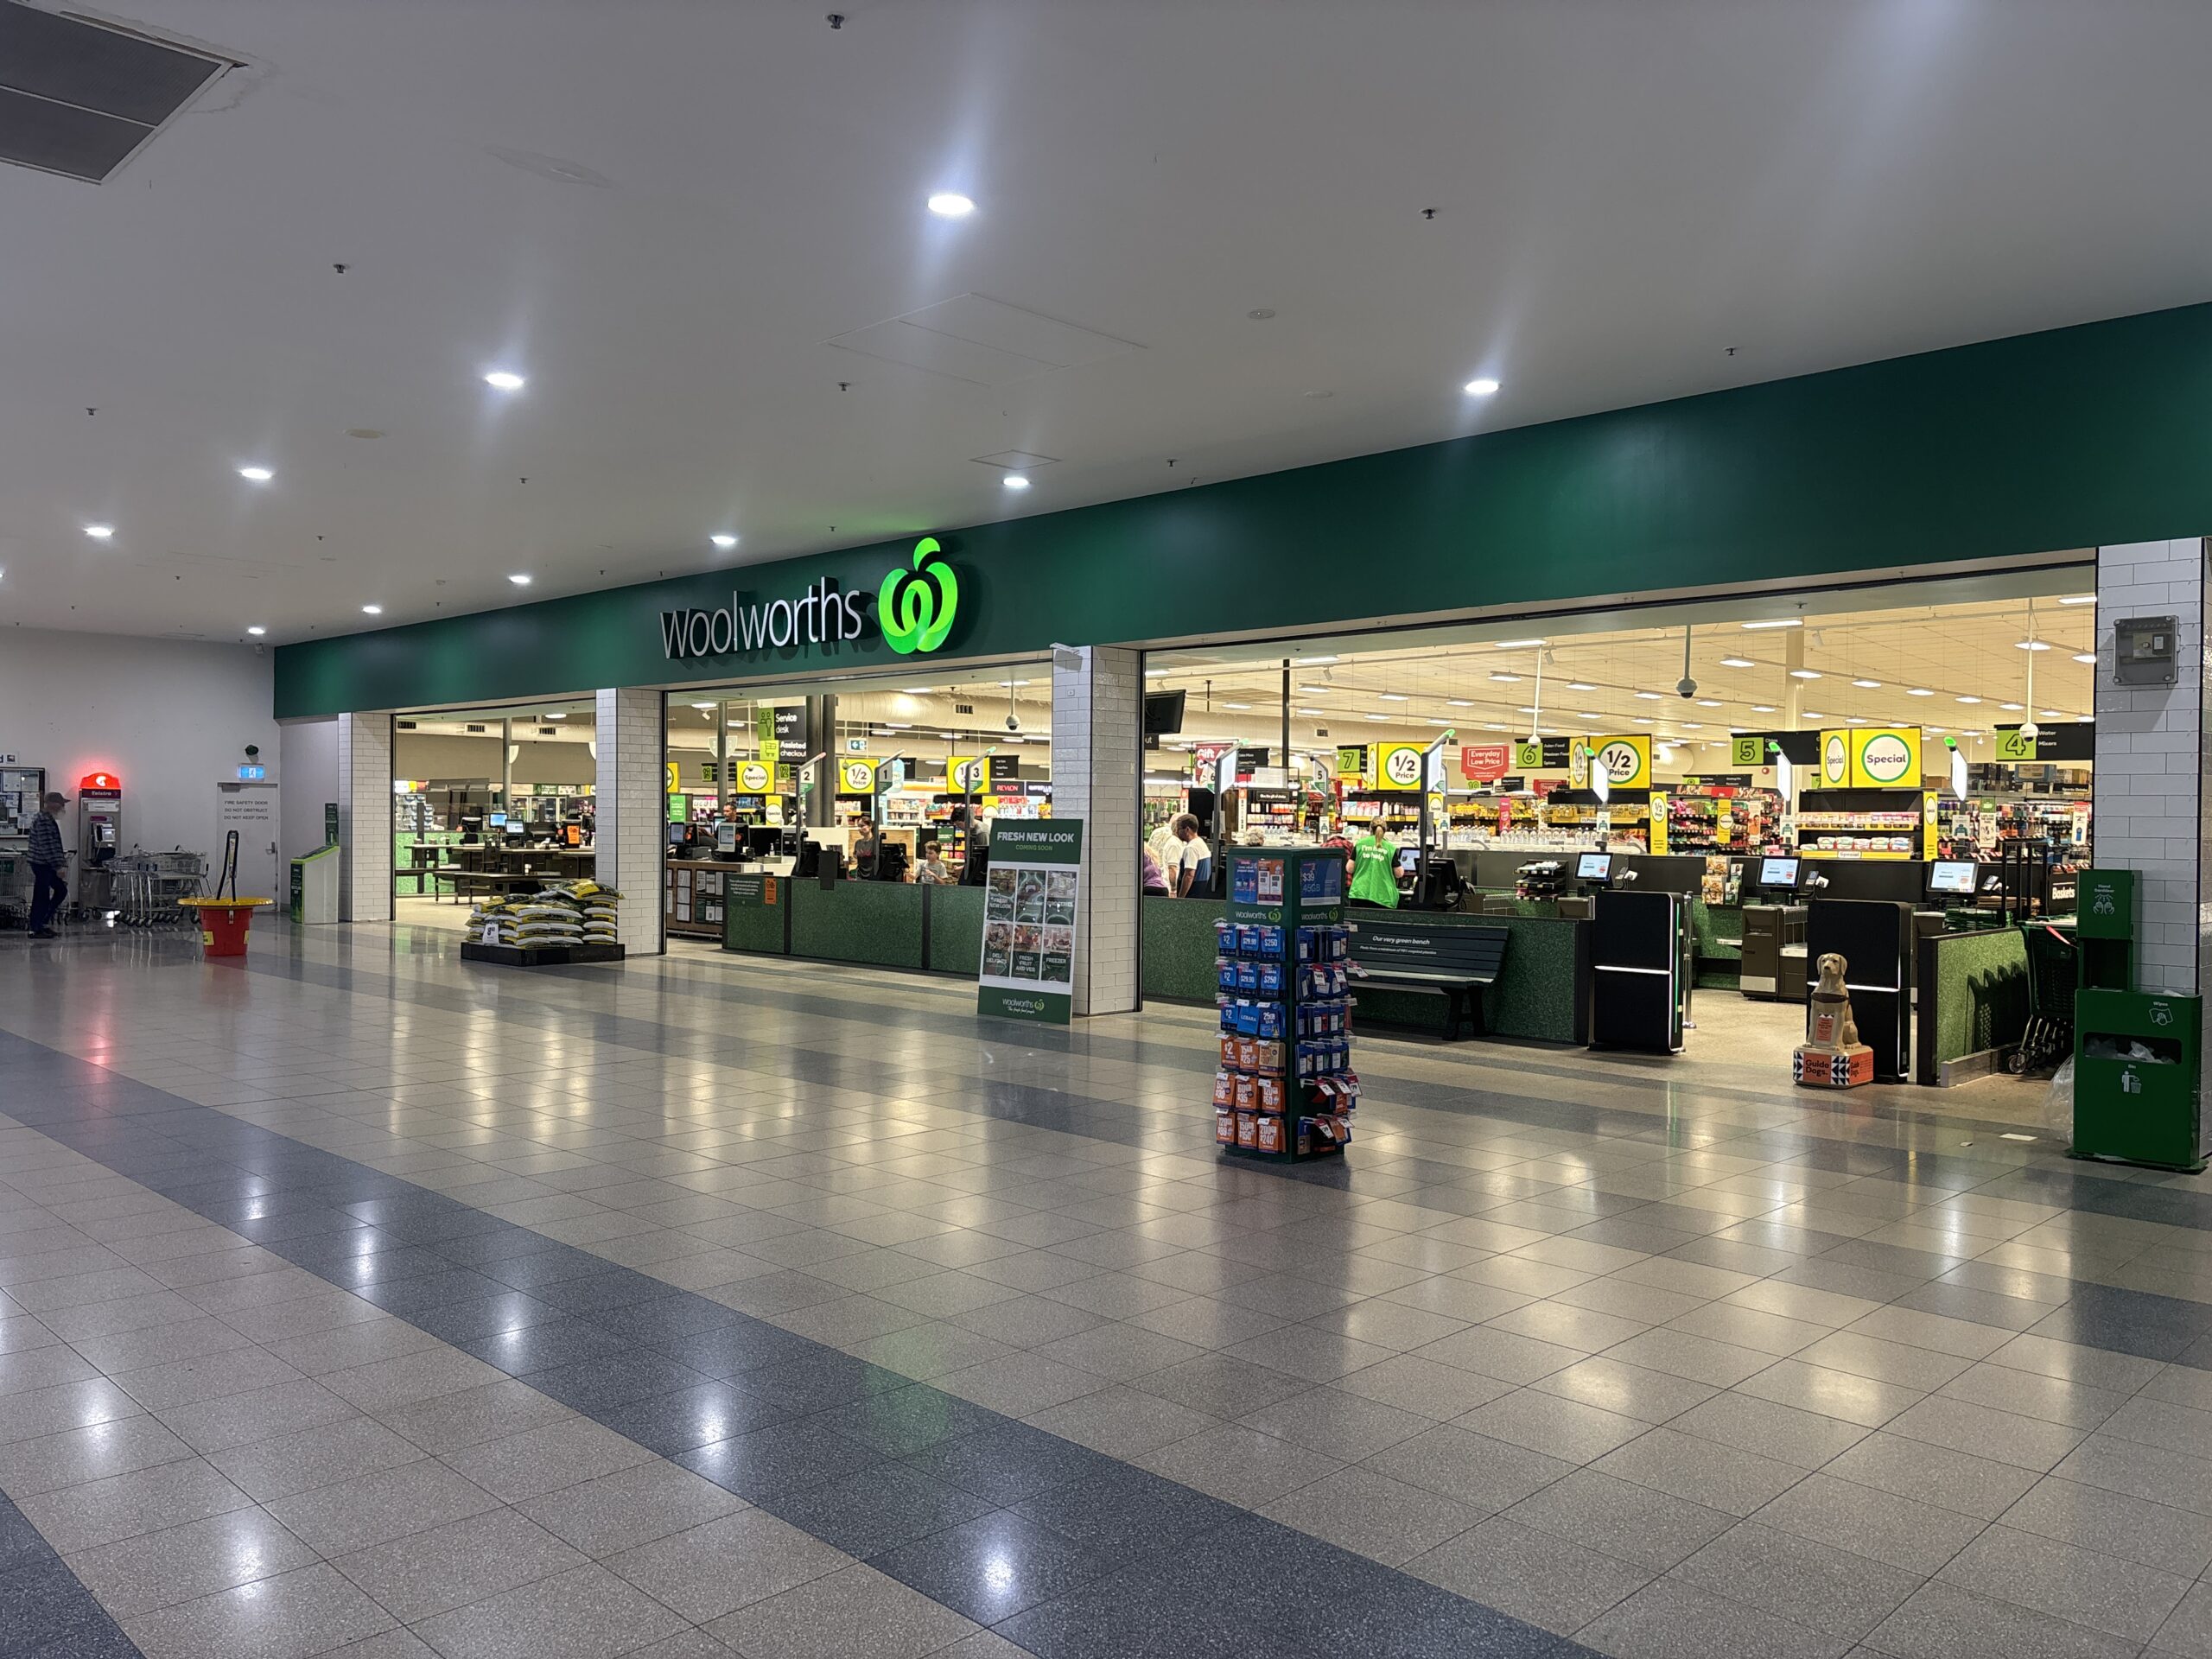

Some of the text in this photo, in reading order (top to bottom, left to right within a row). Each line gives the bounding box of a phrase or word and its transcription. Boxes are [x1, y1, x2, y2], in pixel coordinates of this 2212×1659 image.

[660, 576, 861, 659] woolworths
[775, 713, 798, 722] Service
[776, 725, 790, 734] desk
[779, 741, 806, 749] Assisted
[2005, 734, 2026, 756] 4
[1197, 748, 1215, 759] Gift
[1522, 746, 1536, 765] 6
[1739, 741, 1756, 761] 5
[1343, 752, 1354, 769] 7
[1394, 755, 1415, 772] 1/2
[1607, 750, 1631, 768] 1/2
[1827, 755, 1844, 766] Special
[1866, 754, 1906, 766] Special
[779, 765, 790, 779] 12
[804, 771, 810, 781] 2
[852, 767, 868, 780] 1/2
[883, 769, 888, 779] 1
[973, 767, 980, 778] 3
[1317, 771, 1323, 780] 5
[997, 831, 1074, 843] FRESH NEW LOOK
[1371, 852, 1384, 861] help
[1302, 873, 1315, 882] $39
[1302, 883, 1320, 892] 45GB
[2052, 887, 2075, 899] Baskets
[1235, 910, 1267, 920] woolworths
[1300, 912, 1328, 920] woolworths
[1223, 935, 1230, 944] $2
[1002, 997, 1034, 1008] woolworths
[1224, 1041, 1233, 1054] $2
[1805, 1059, 1829, 1069] Guide
[1805, 1066, 1828, 1077] Dogs.
